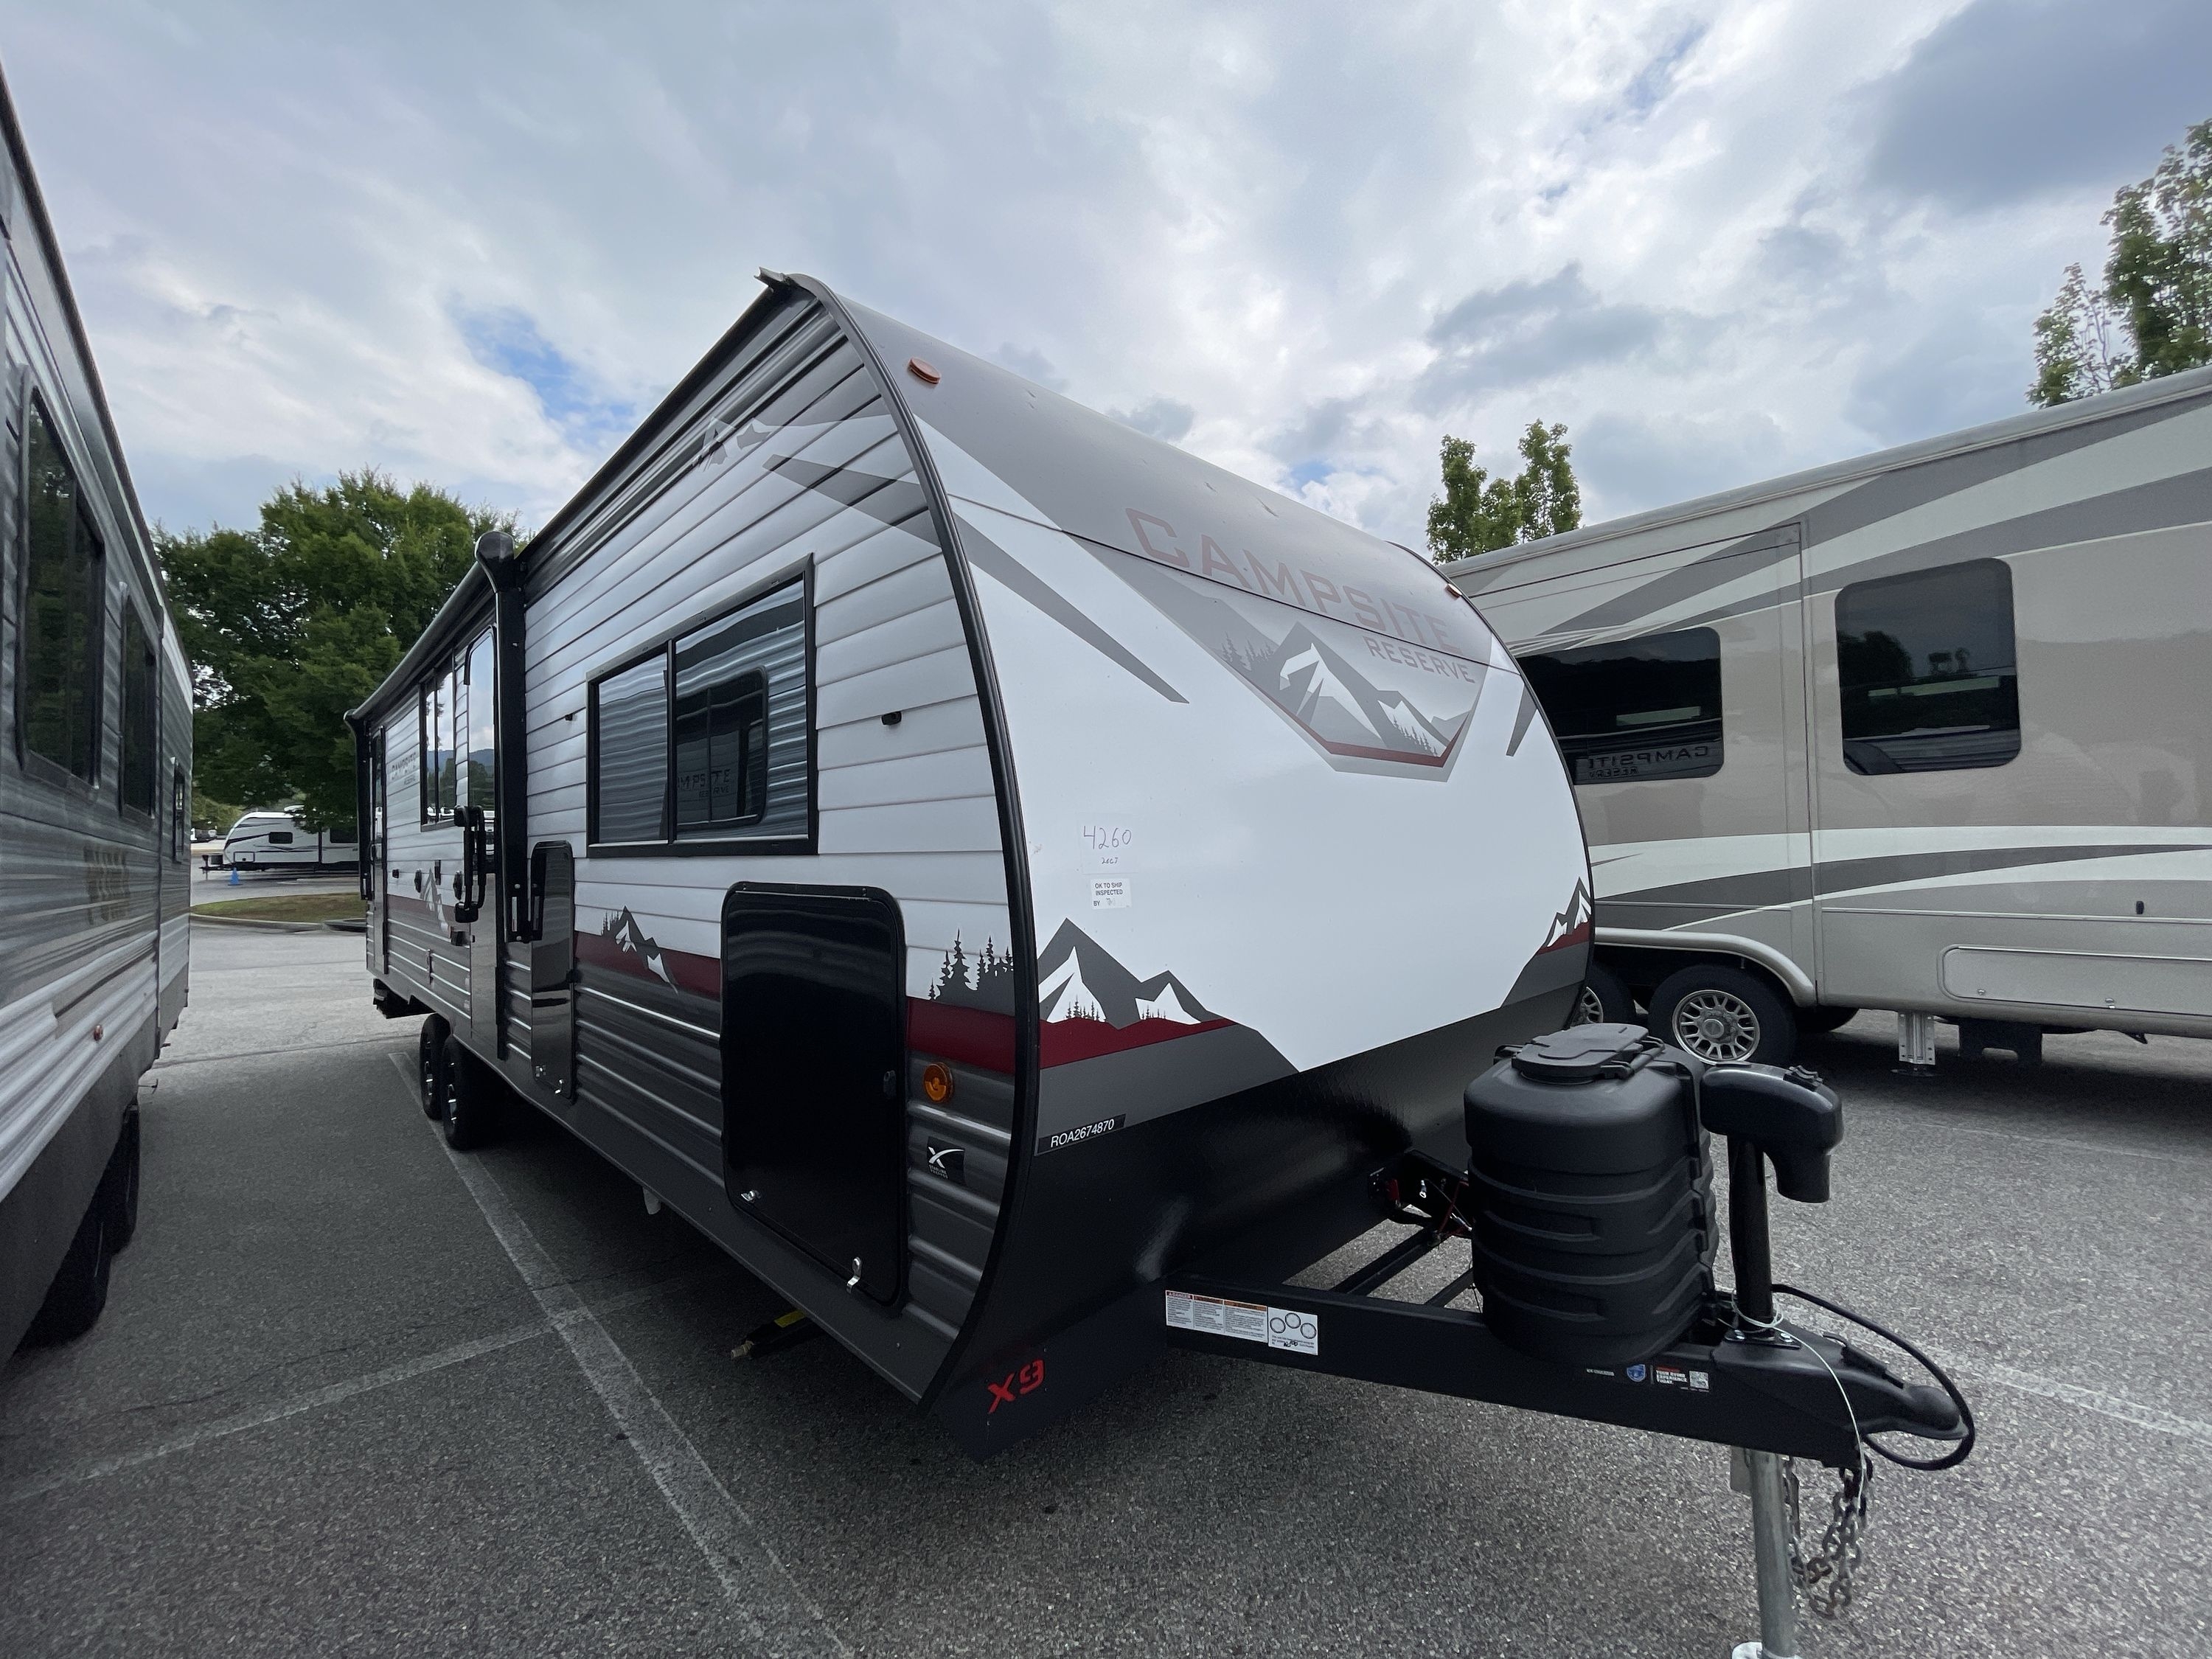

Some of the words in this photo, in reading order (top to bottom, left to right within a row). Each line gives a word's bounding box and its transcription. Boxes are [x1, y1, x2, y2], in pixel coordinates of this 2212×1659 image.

[1125, 507, 1462, 655] CAMPSITE
[1363, 635, 1475, 684] RESERVE
[1083, 825, 1132, 849] 4260
[1050, 1118, 1115, 1148] ROA2674870
